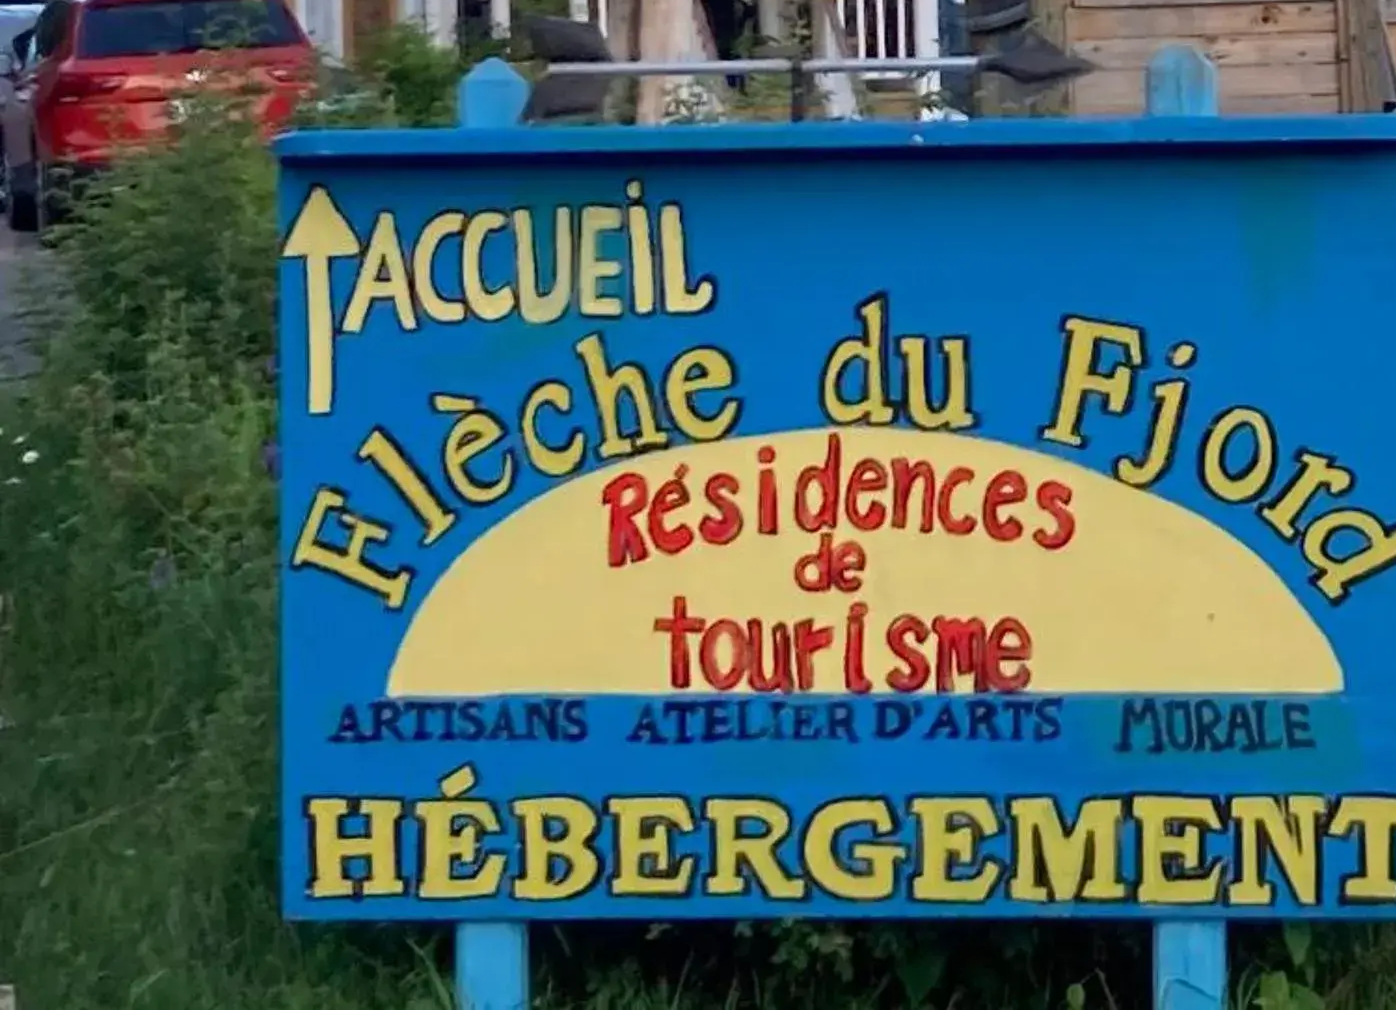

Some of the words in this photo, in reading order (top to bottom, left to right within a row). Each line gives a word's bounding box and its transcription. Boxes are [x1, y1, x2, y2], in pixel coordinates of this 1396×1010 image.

[290, 328, 745, 612] Flèche
[820, 290, 976, 430] du
[600, 430, 1078, 570] Résidences
[794, 530, 868, 593] de
[653, 594, 1034, 695] tourisme
[326, 699, 590, 744] ARTISANS
[624, 700, 859, 744] ATELIER
[874, 697, 1064, 742] D'ARTS
